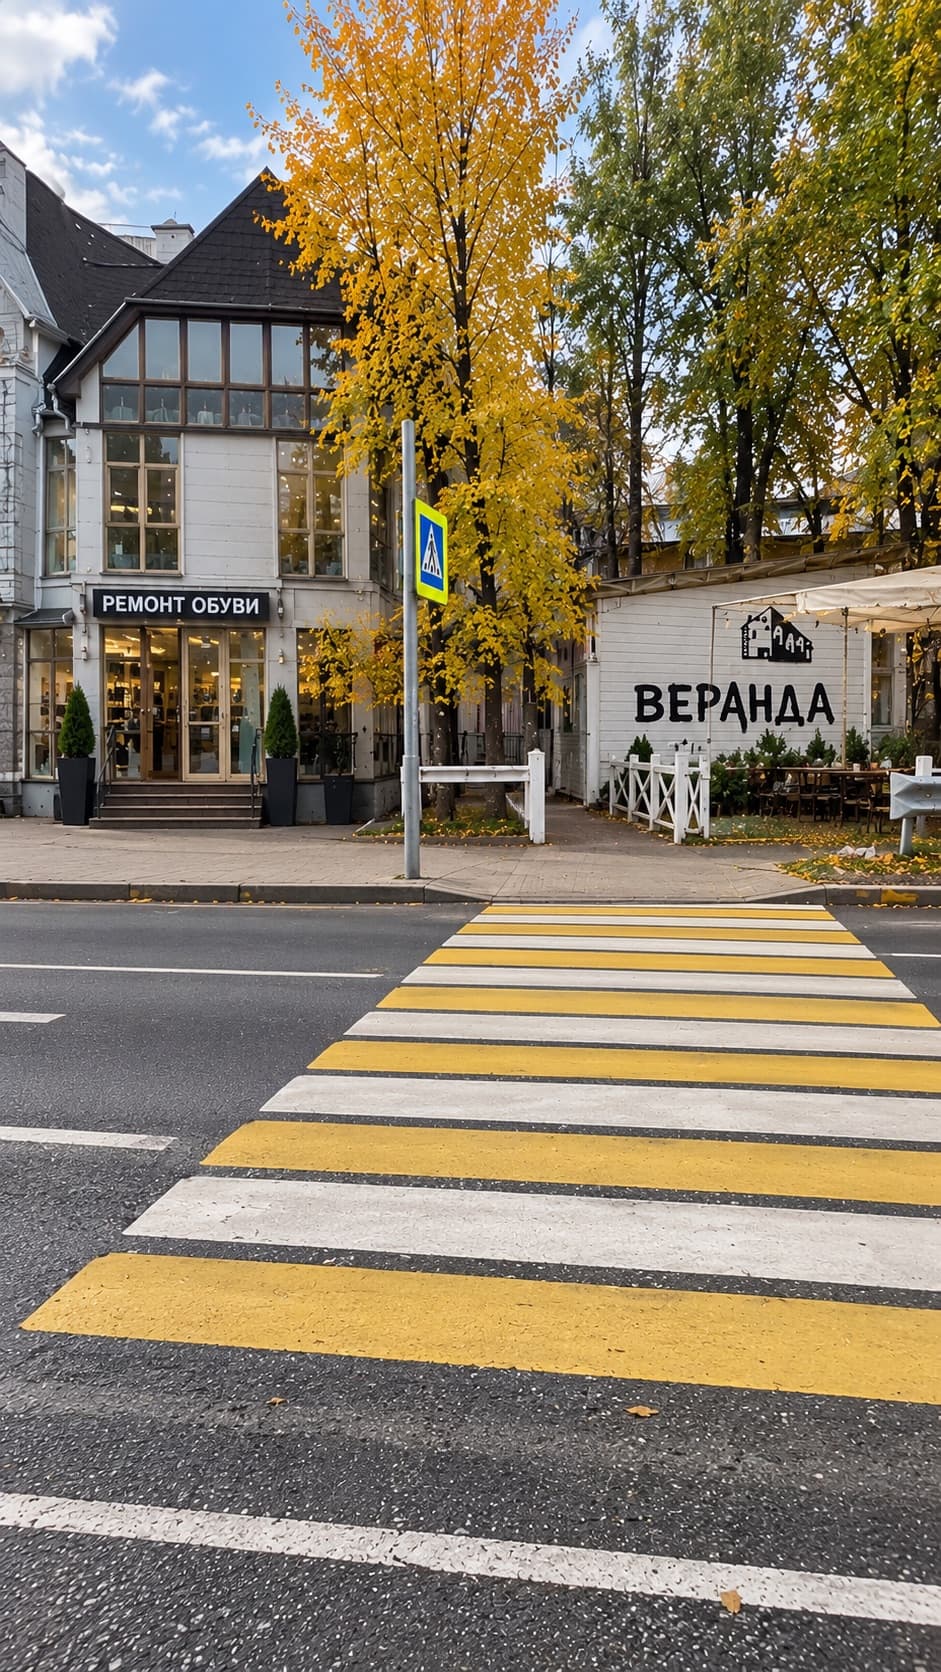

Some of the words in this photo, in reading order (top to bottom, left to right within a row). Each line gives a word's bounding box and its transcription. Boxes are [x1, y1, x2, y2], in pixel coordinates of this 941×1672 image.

[102, 595, 185, 613] РЕМОНТ
[191, 597, 259, 615] ОБУВИ
[634, 681, 835, 734] ВЕРАНДА
